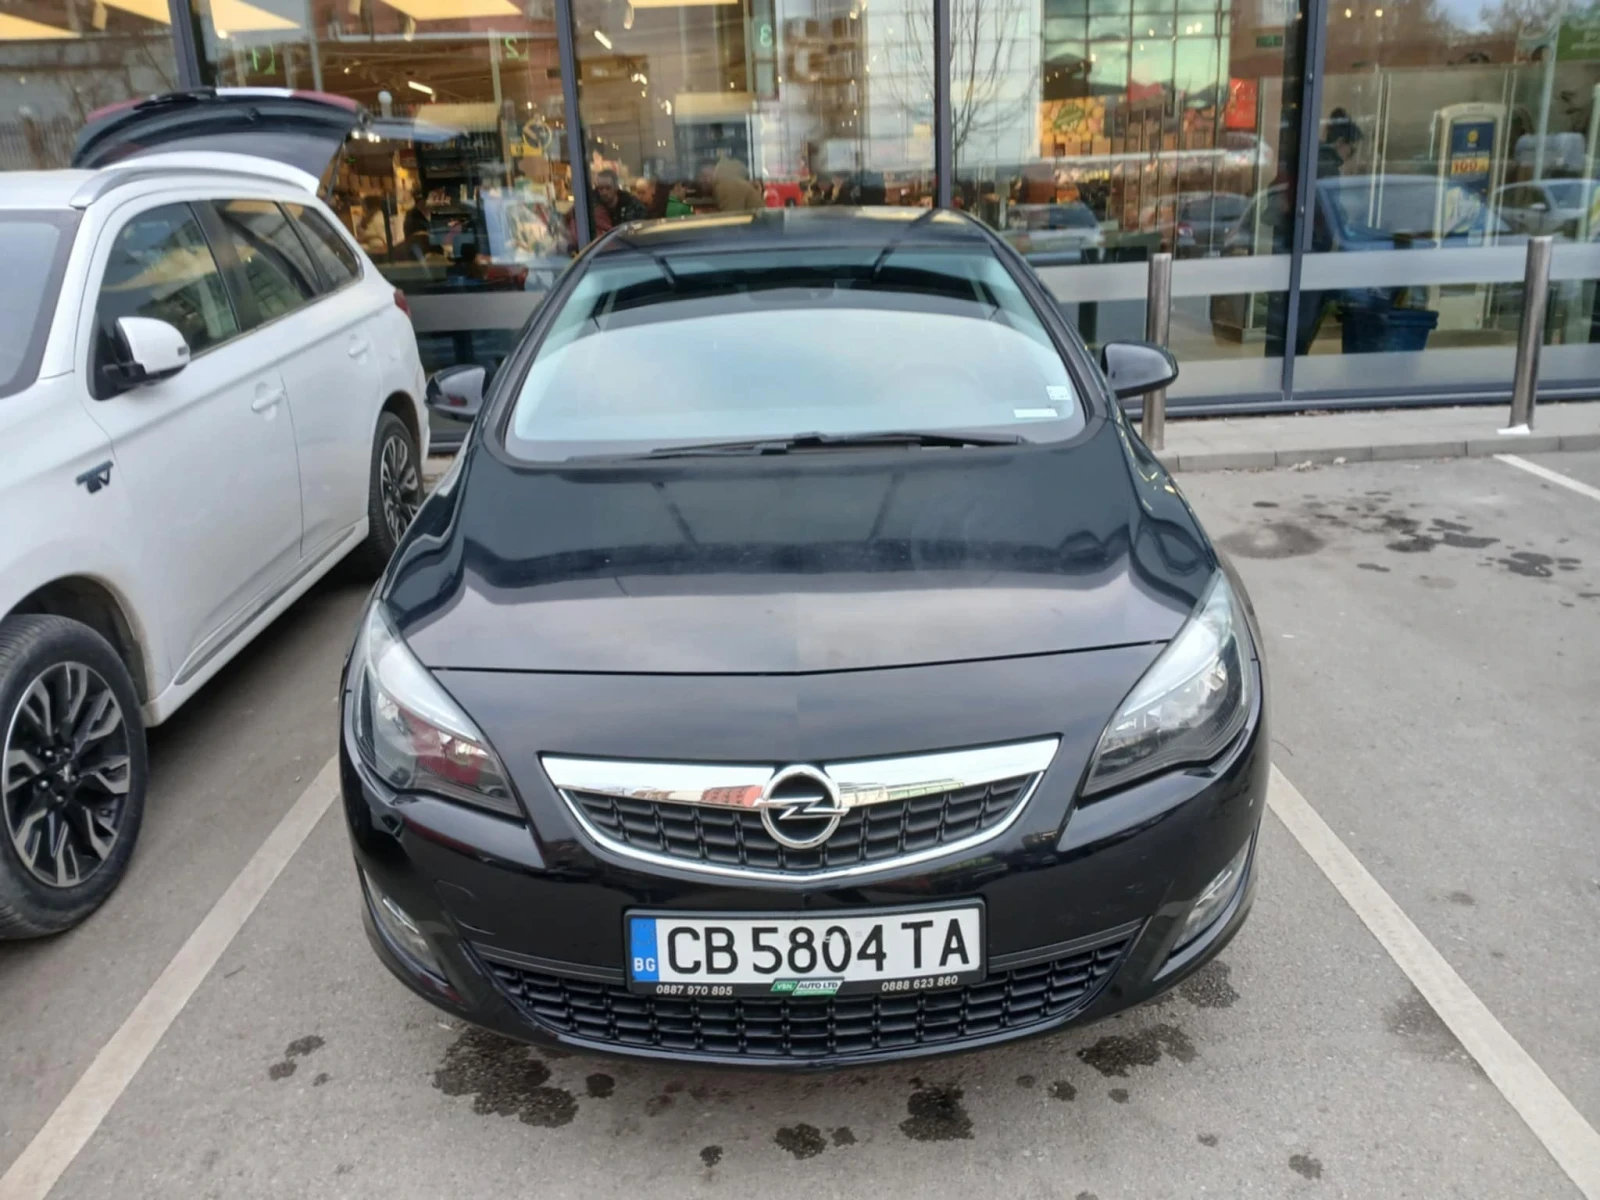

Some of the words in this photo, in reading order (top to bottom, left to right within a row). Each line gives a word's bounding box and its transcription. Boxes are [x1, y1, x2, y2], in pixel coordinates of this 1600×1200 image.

[667, 926, 739, 975] CB
[751, 924, 887, 974] 5804
[901, 918, 970, 969] TA
[633, 957, 656, 973] BG
[656, 984, 683, 995] 0887
[687, 985, 708, 996] 970
[711, 985, 733, 996] 895
[881, 981, 909, 992] 0888
[913, 977, 933, 989] 623
[936, 975, 959, 987] 860
